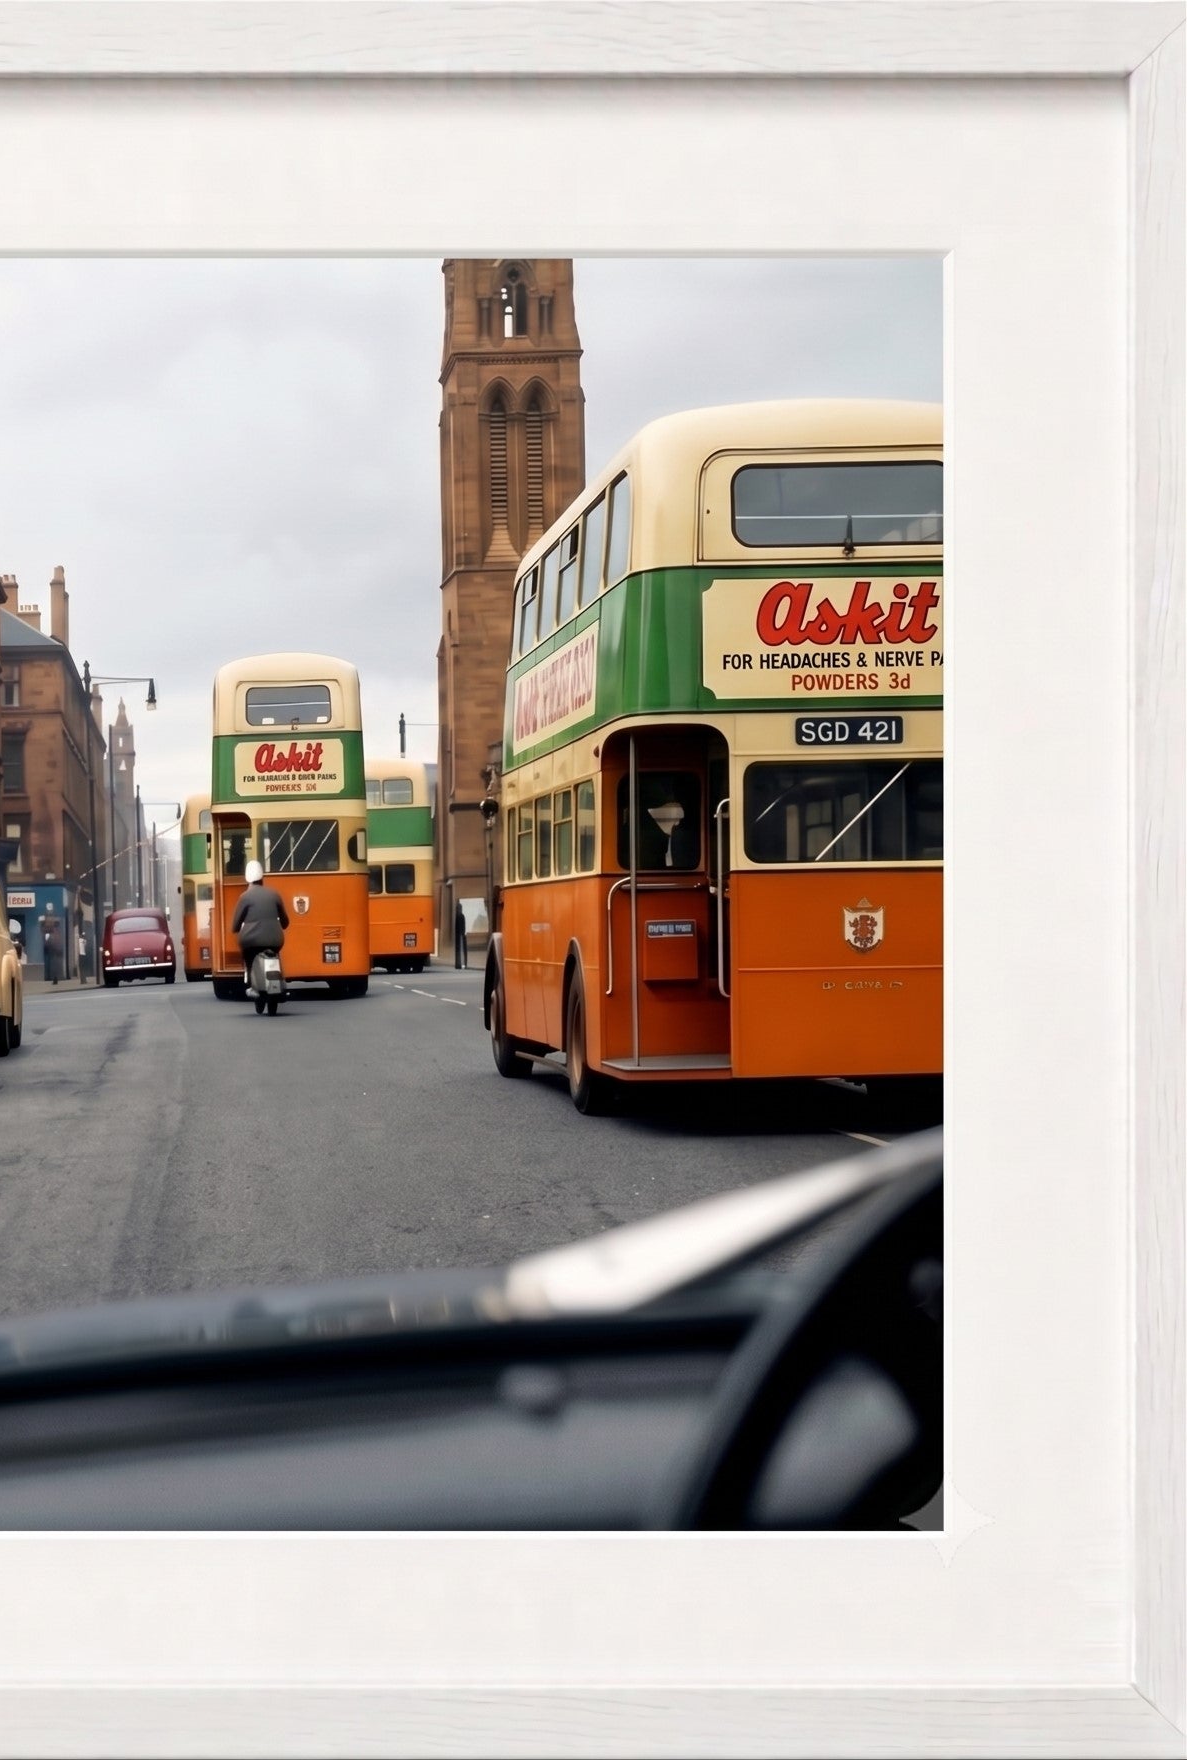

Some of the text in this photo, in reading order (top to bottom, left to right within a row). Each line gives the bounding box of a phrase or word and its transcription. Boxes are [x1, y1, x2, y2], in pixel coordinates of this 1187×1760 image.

[722, 654, 753, 670] FOR
[759, 652, 851, 670] HEADACHES
[856, 651, 868, 668] &
[875, 651, 924, 667] NERVE
[791, 672, 911, 691] POWDERS 3d
[801, 721, 897, 743] SGD 421
